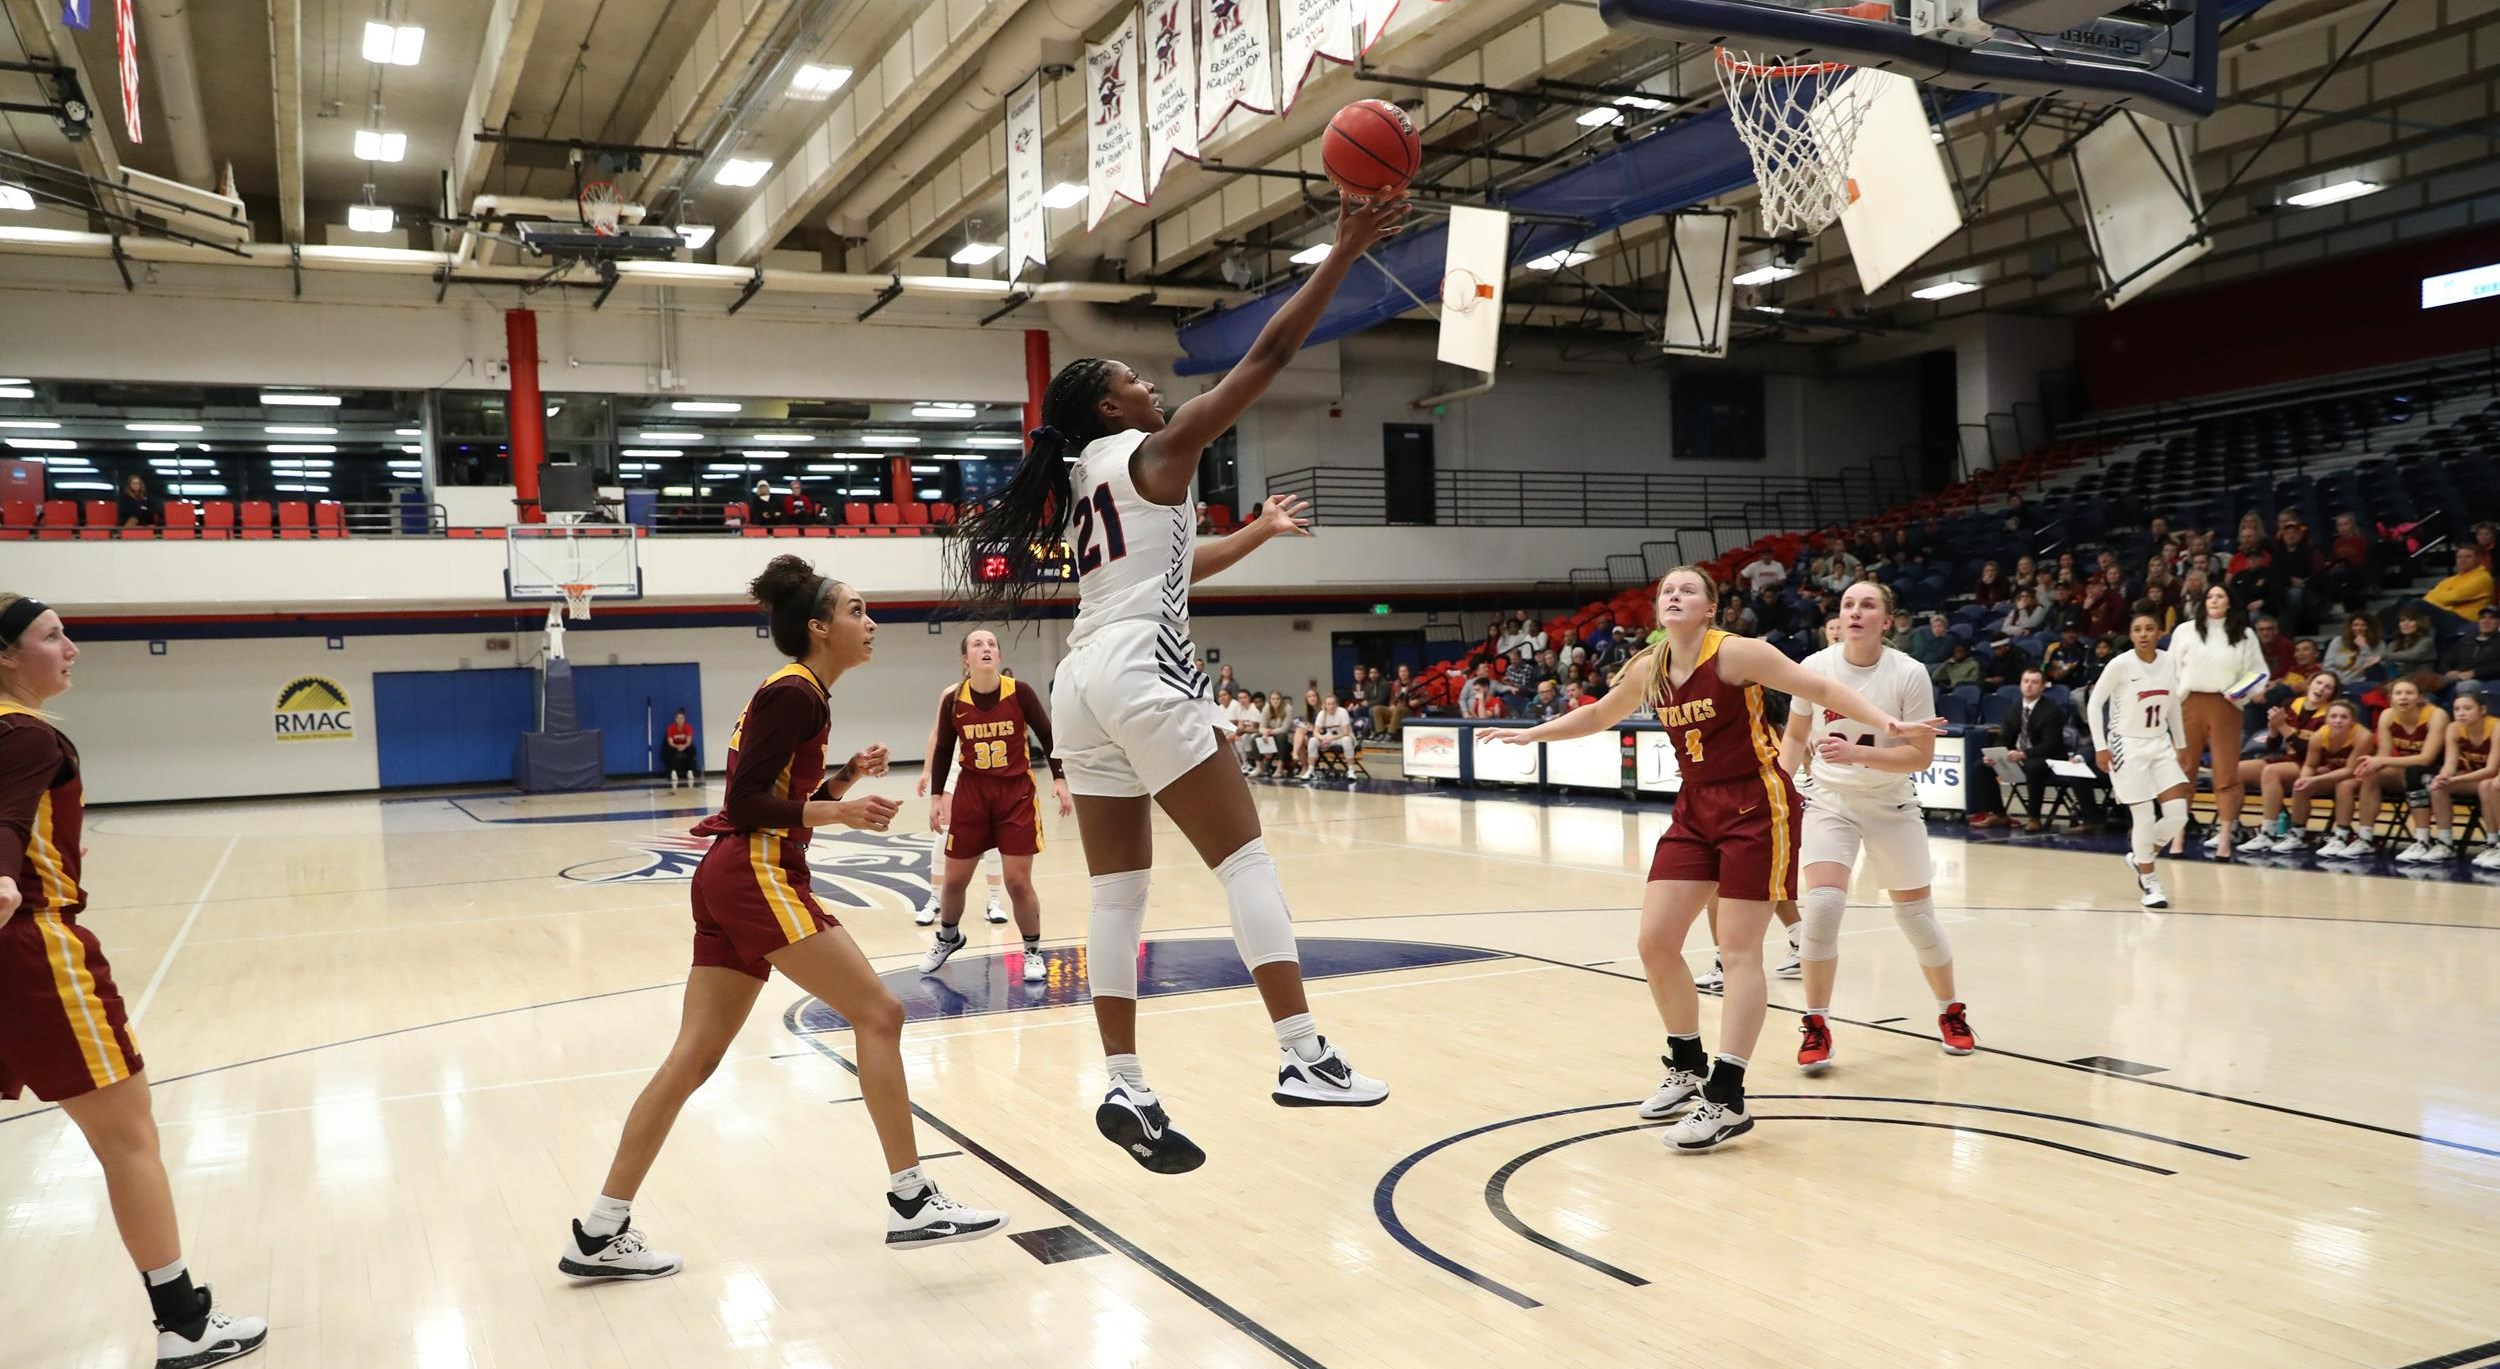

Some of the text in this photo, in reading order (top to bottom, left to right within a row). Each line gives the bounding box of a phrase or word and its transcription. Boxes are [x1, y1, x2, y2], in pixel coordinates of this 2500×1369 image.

[1072, 481, 1127, 577] 21
[1061, 563, 1072, 579] 2
[275, 711, 352, 732] RMAC
[2145, 704, 2161, 728] 11
[963, 720, 1015, 740] WOLVES
[973, 740, 1008, 770] 32
[1684, 728, 1705, 763] 4
